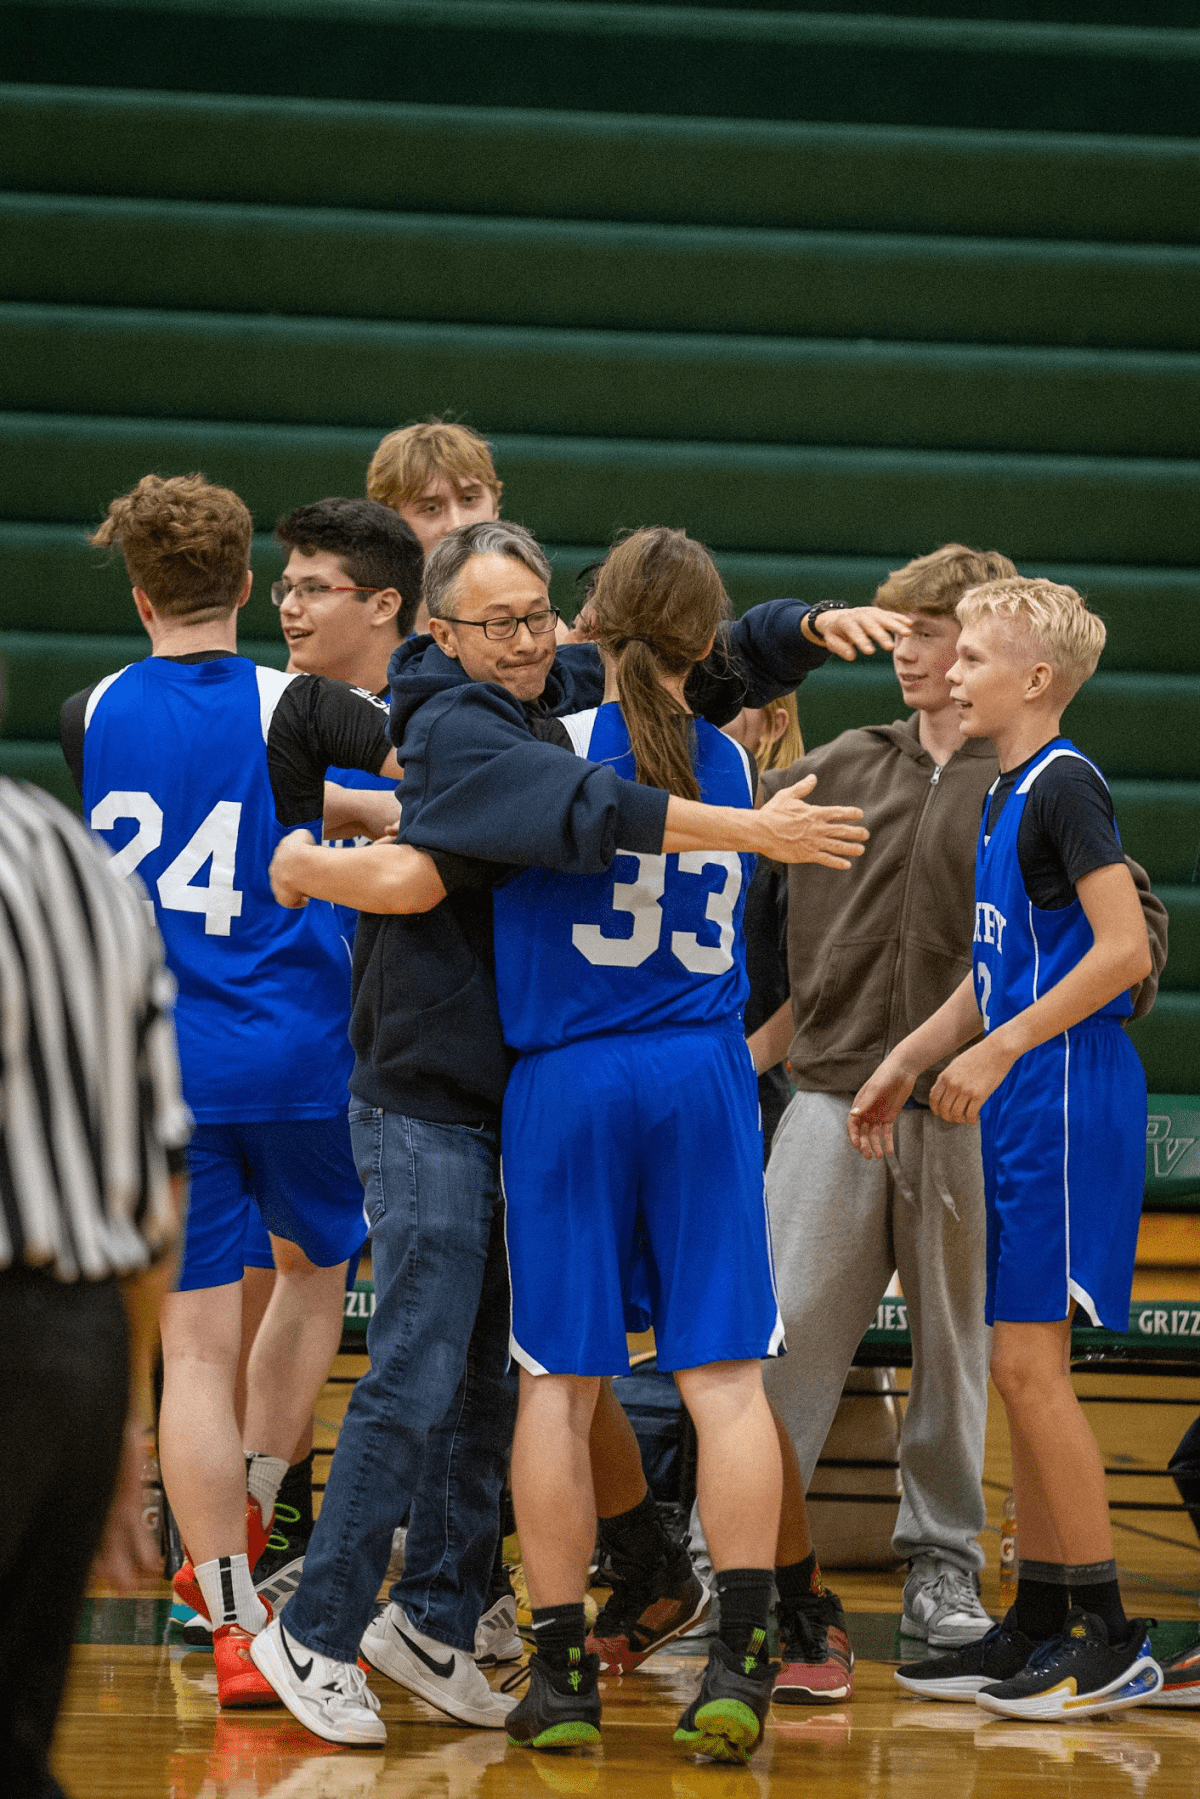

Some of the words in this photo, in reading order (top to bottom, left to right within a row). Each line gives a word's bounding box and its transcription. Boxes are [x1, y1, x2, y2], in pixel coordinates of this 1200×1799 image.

[91, 790, 243, 937] 24
[572, 848, 742, 976] 33
[868, 1304, 908, 1330] IES
[1138, 1310, 1200, 1336] GRIZZ
